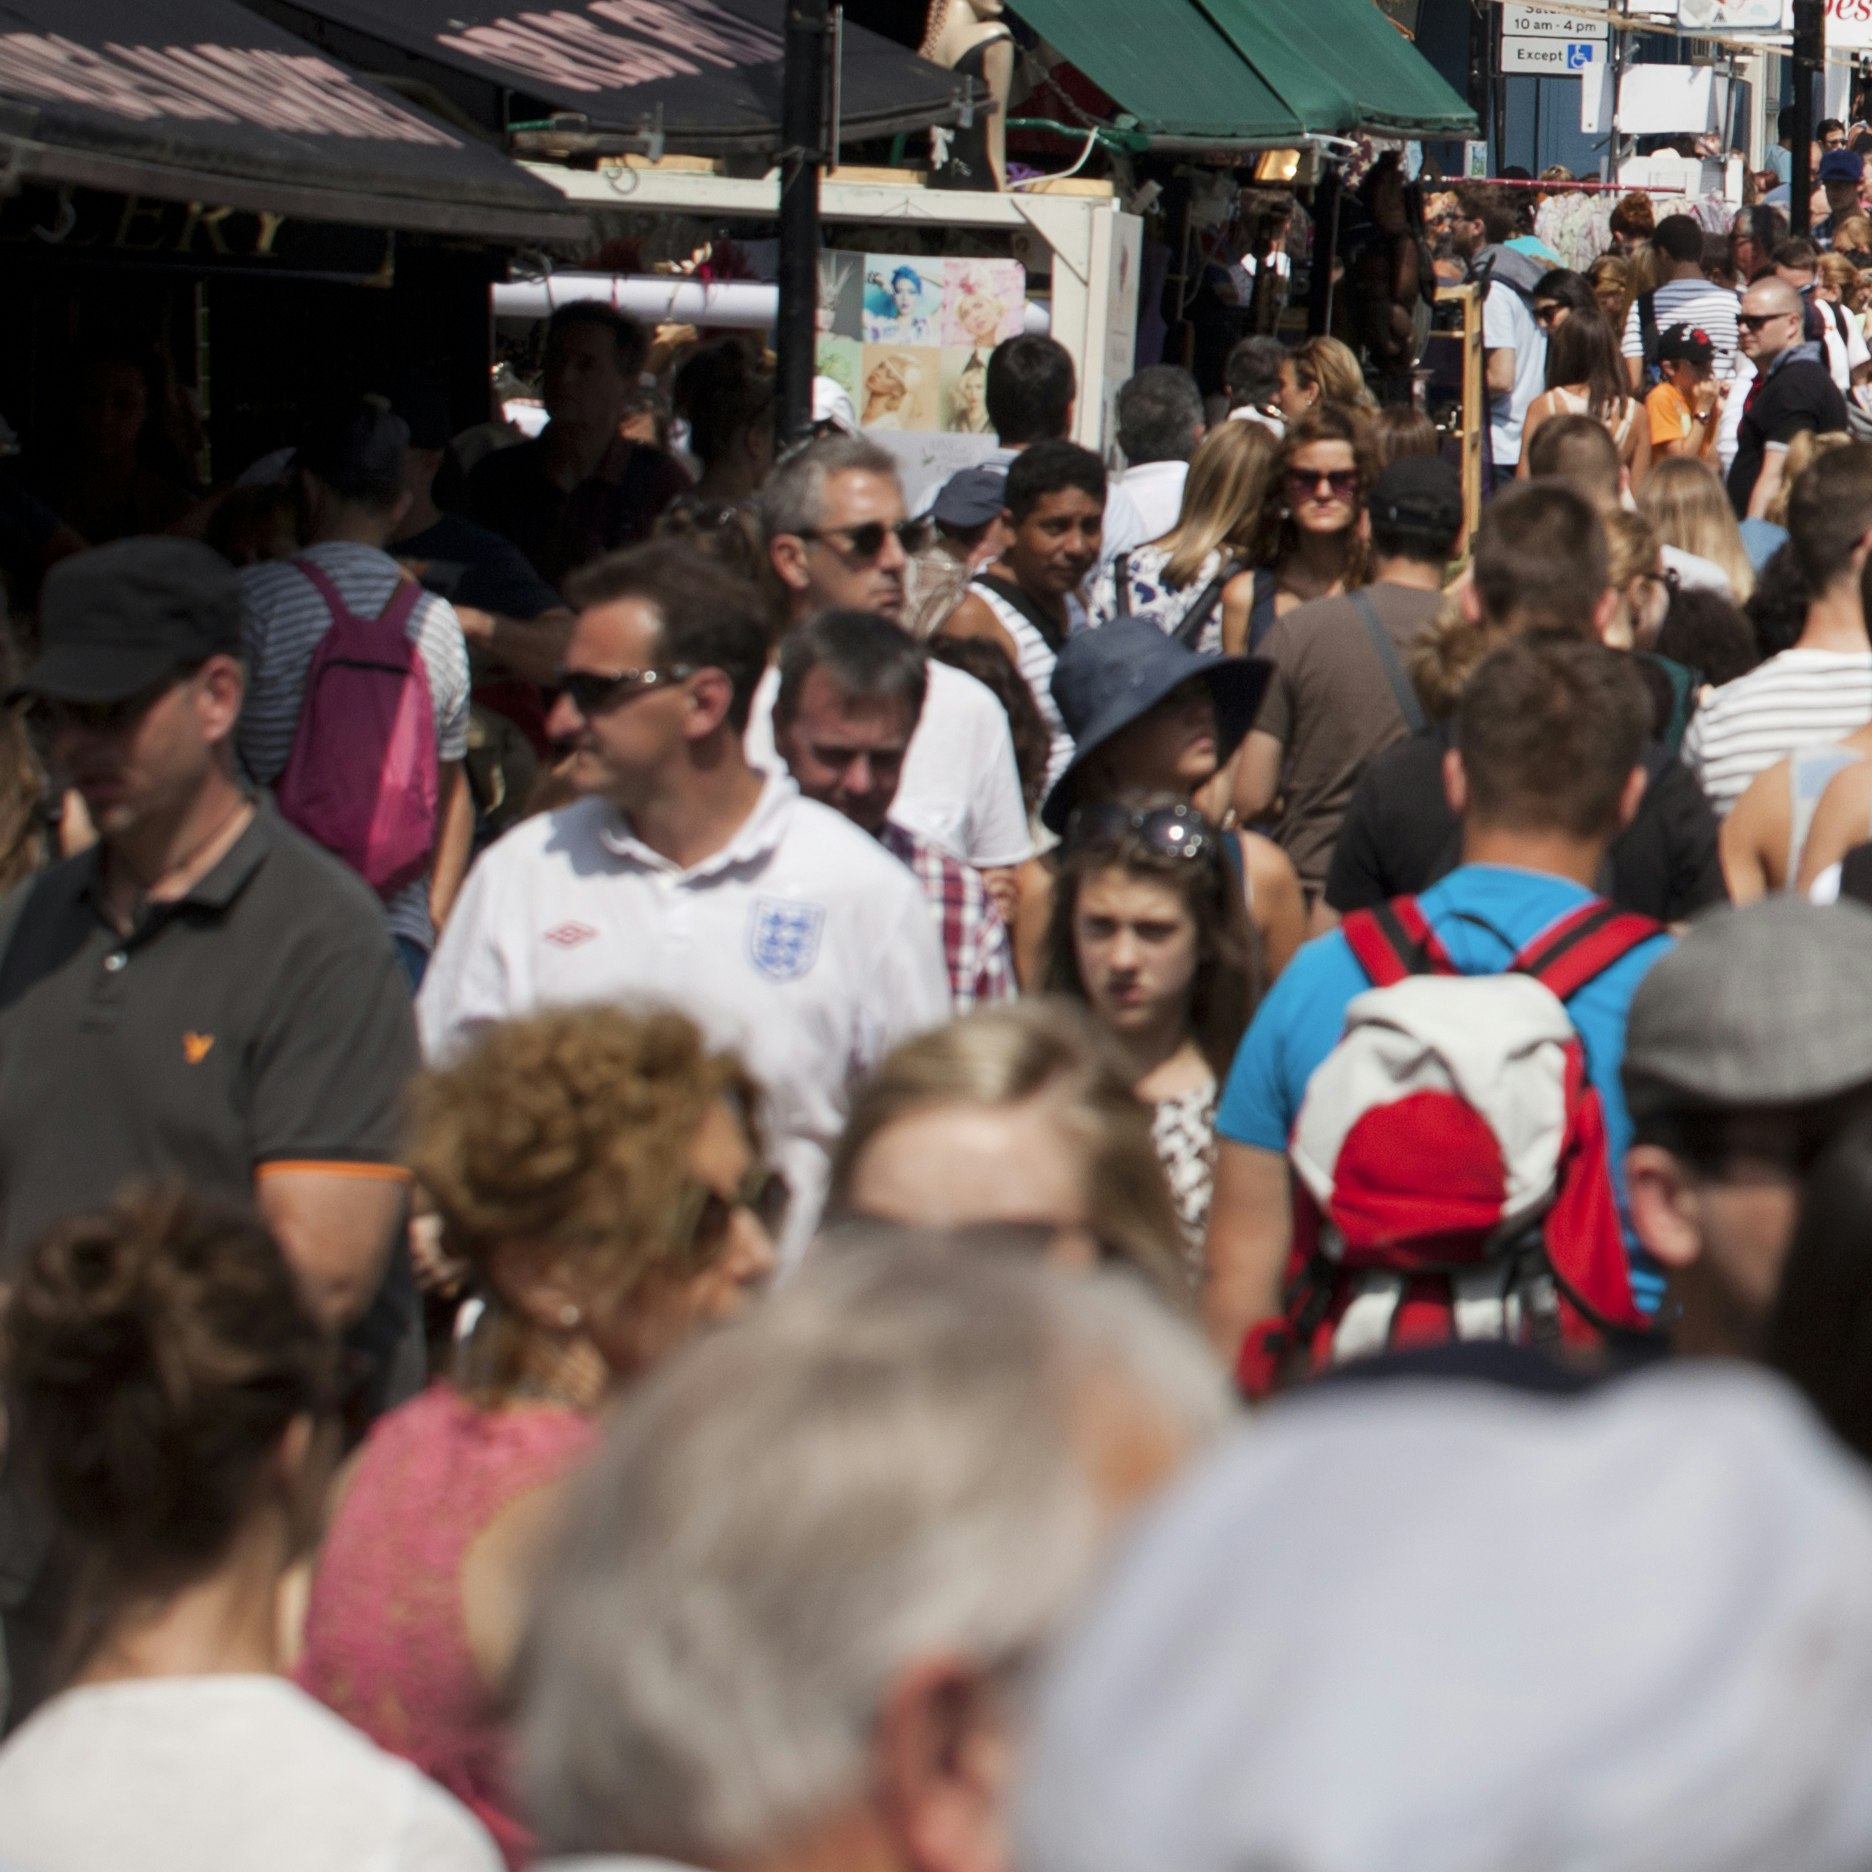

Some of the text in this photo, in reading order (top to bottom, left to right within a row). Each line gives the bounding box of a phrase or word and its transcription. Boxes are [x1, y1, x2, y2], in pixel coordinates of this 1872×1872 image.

[1515, 19, 1530, 30] 10
[1533, 21, 1552, 30] am
[1563, 20, 1572, 31] 4
[1576, 22, 1596, 34] pm
[1517, 49, 1563, 63] Except
